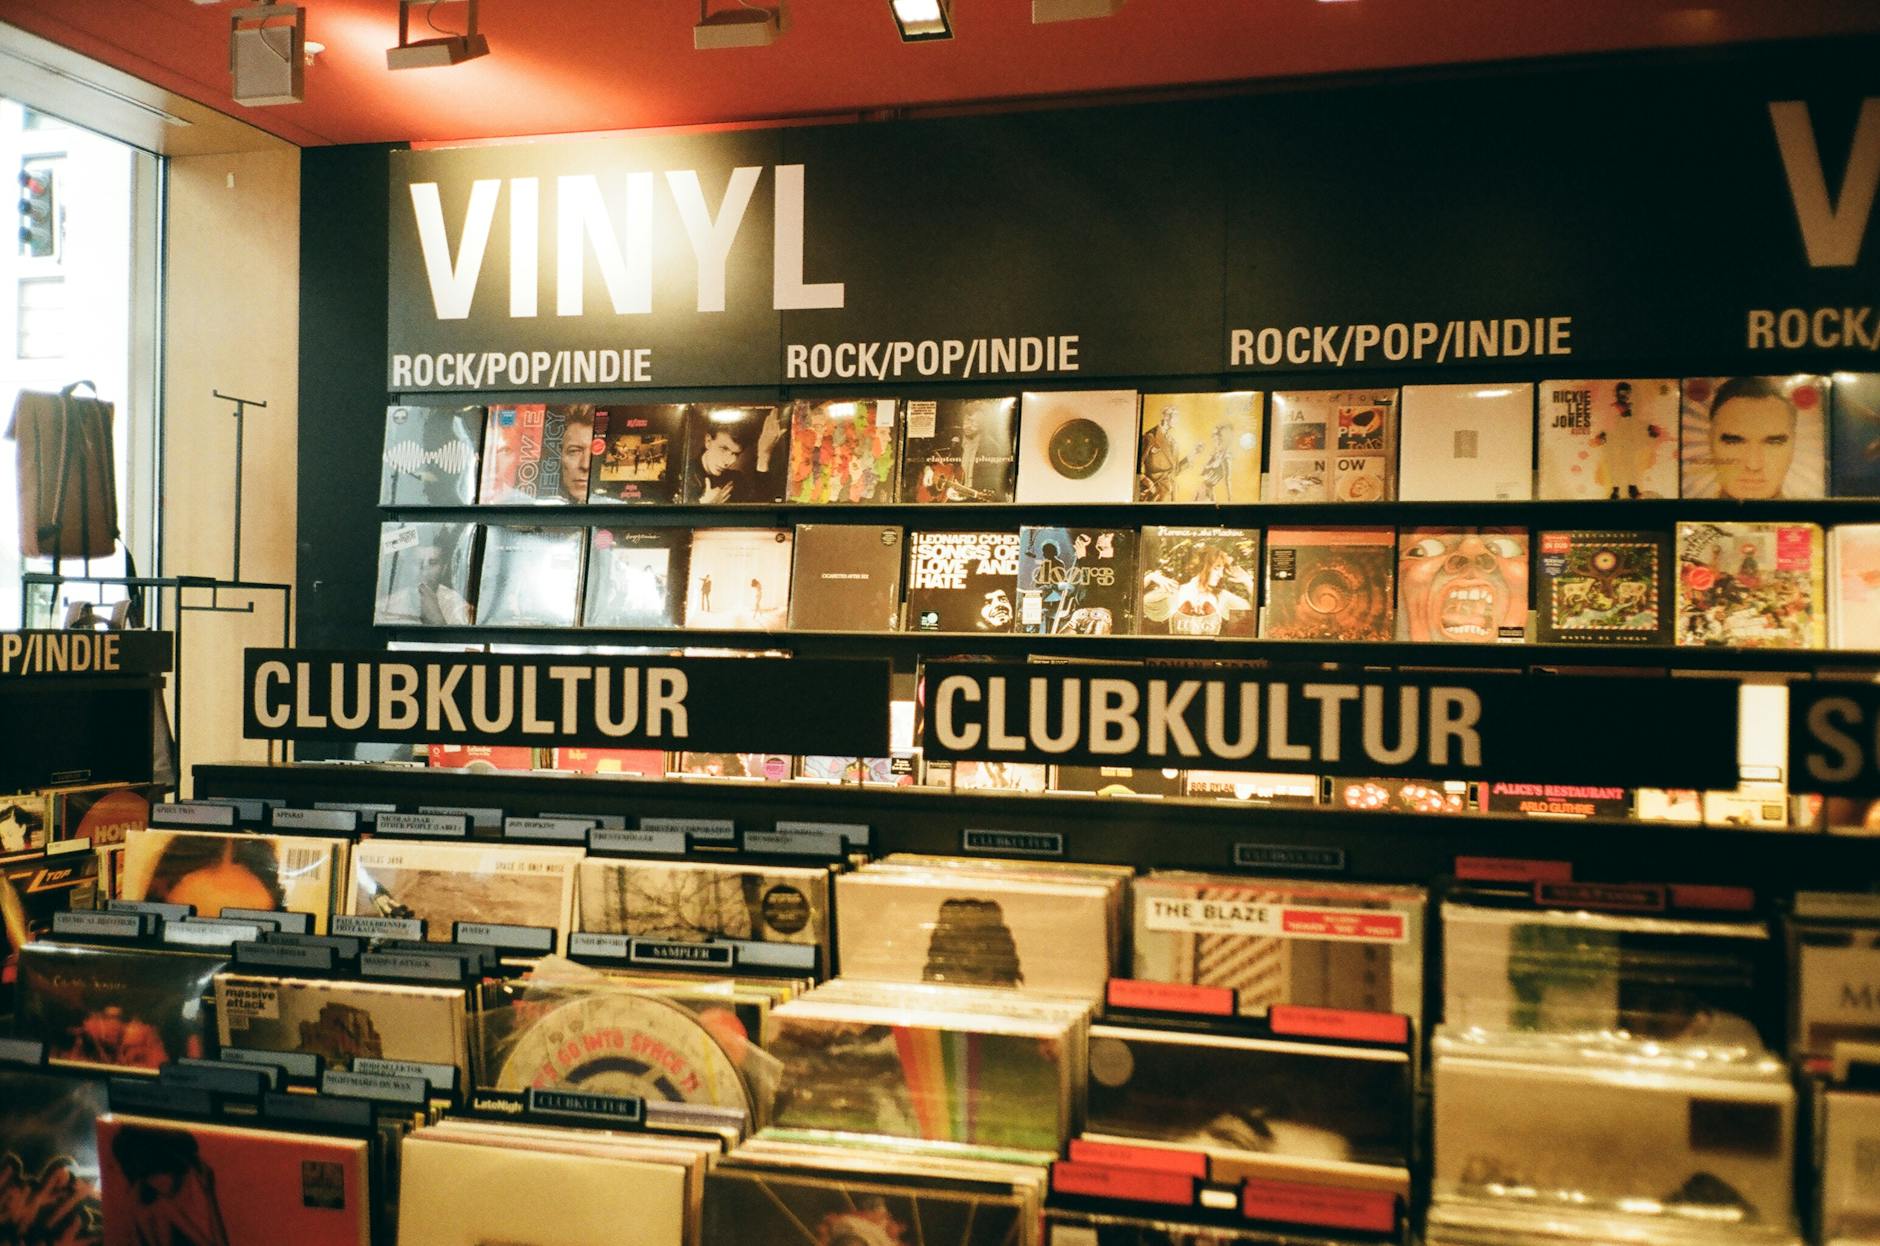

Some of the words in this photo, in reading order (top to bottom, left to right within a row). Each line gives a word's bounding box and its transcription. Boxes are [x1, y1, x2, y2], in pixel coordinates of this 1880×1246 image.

[409, 164, 845, 320] VINYL
[1230, 316, 1573, 367] ROCK/POP/INDIE
[786, 335, 1080, 381] ROCK/POP/INDIE
[392, 349, 652, 389] ROCK/POP/INDIE
[1552, 390, 1591, 403] RICKIE
[1567, 402, 1591, 416] LEE
[1552, 415, 1591, 428] JONES
[919, 534, 975, 545] LEONARD
[978, 535, 1020, 545] COHEN
[916, 545, 991, 560] SONGS
[915, 559, 968, 575] LOVE
[975, 560, 1020, 575] AND
[913, 574, 967, 589] HATE
[2, 634, 120, 676] P/INDIE
[254, 661, 689, 738] CLUBKULTUR
[935, 674, 1484, 768] CLUBKULTUR
[1807, 697, 1880, 781] S
[1493, 782, 1543, 794] ALICE'S
[1544, 784, 1625, 799] RESTAURANT
[1519, 801, 1549, 812] ARLO
[1550, 802, 1596, 815] GUTHRIE
[46, 868, 72, 881] TOP
[1154, 902, 1193, 917] THE
[1203, 903, 1270, 922] BLAZE
[653, 945, 710, 960] SAMPLER
[226, 989, 276, 1000] massive
[226, 999, 265, 1010] attack
[539, 1094, 629, 1113] CLUBKULTUR
